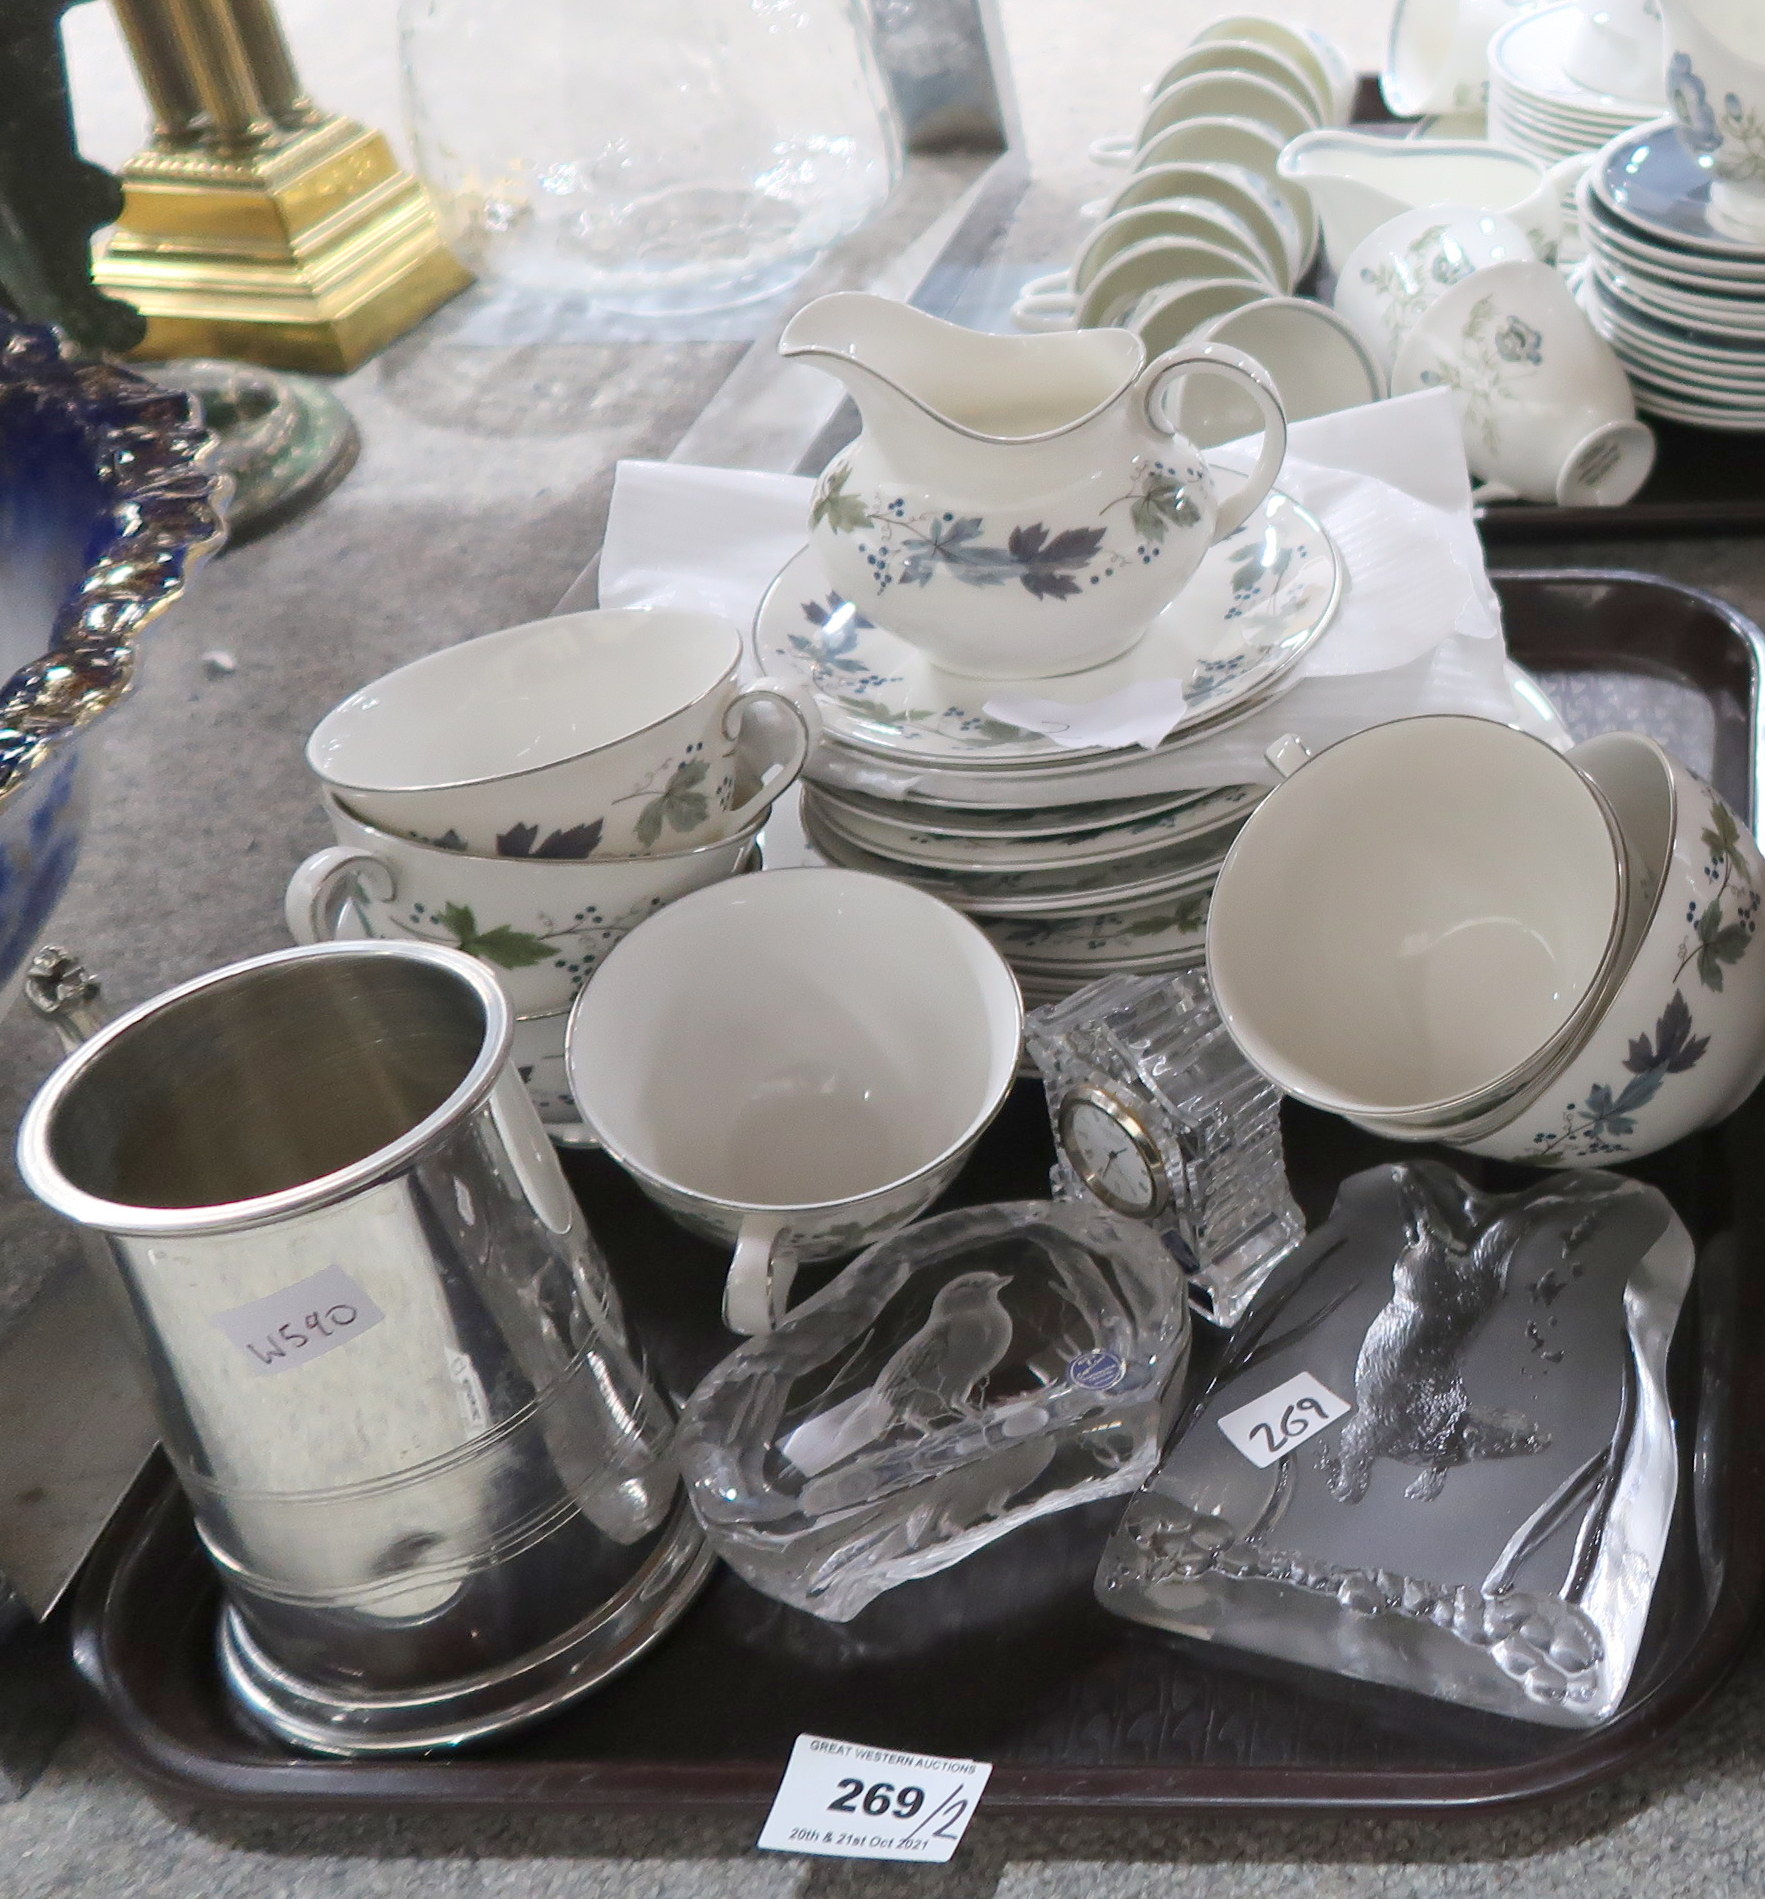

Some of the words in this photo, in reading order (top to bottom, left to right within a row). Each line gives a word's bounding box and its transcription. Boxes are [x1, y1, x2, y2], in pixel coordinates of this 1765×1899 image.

[246, 1304, 357, 1364] W590
[1249, 1397, 1329, 1452] 269
[810, 1740, 852, 1755] GREAT
[855, 1747, 914, 1767] WESTERN
[915, 1758, 976, 1775] AUCTIONS
[789, 1827, 819, 1842] 20th
[822, 1833, 833, 1844] &
[836, 1834, 867, 1847] 21st
[870, 1836, 894, 1849] Oct
[898, 1839, 929, 1850] 2021
